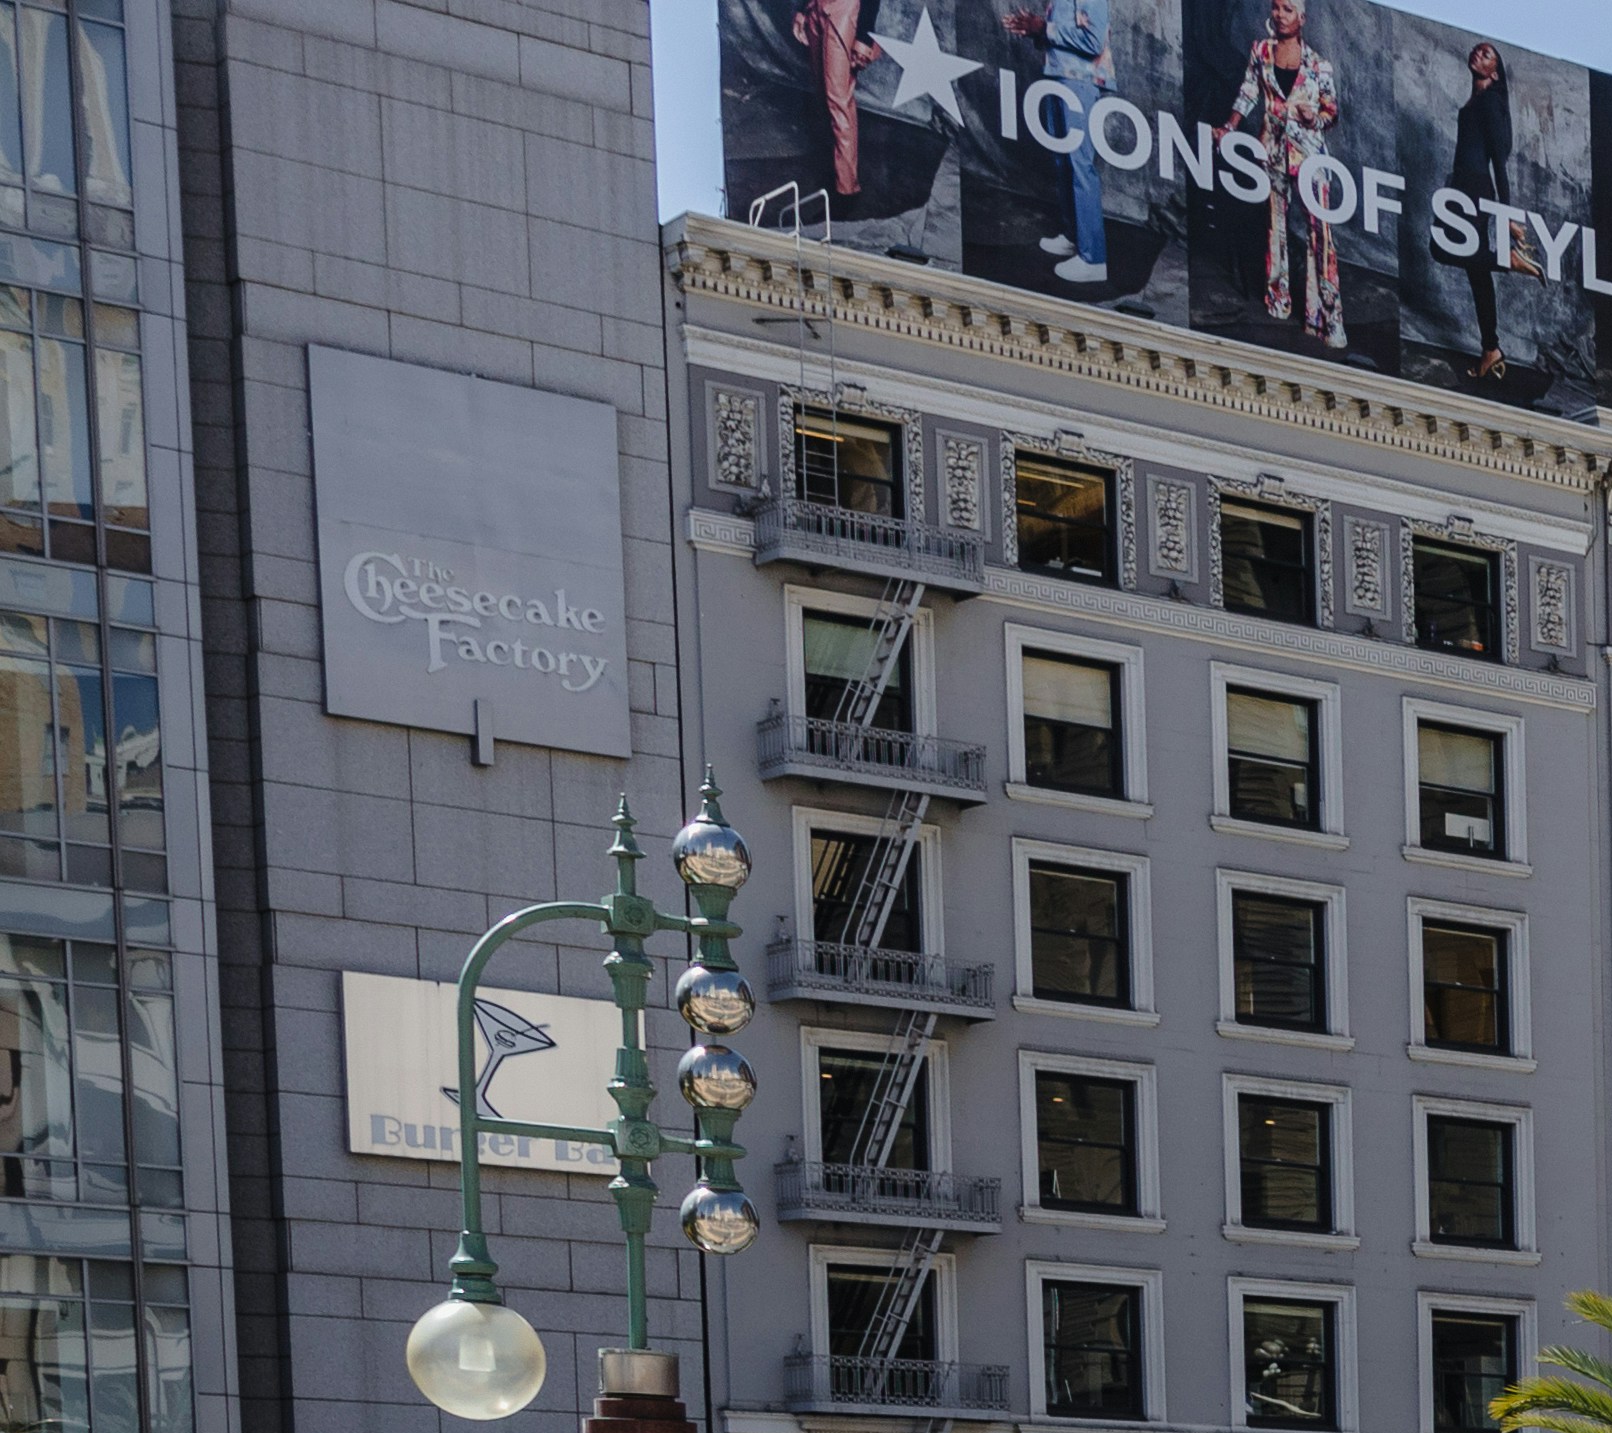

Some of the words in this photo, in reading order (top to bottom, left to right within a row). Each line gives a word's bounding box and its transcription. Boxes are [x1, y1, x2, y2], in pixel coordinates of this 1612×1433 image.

[1000, 69, 1271, 204] ICONS
[1297, 156, 1406, 236] OF
[344, 551, 606, 634] Cheesecake
[407, 557, 456, 584] The
[400, 605, 609, 692] Factory
